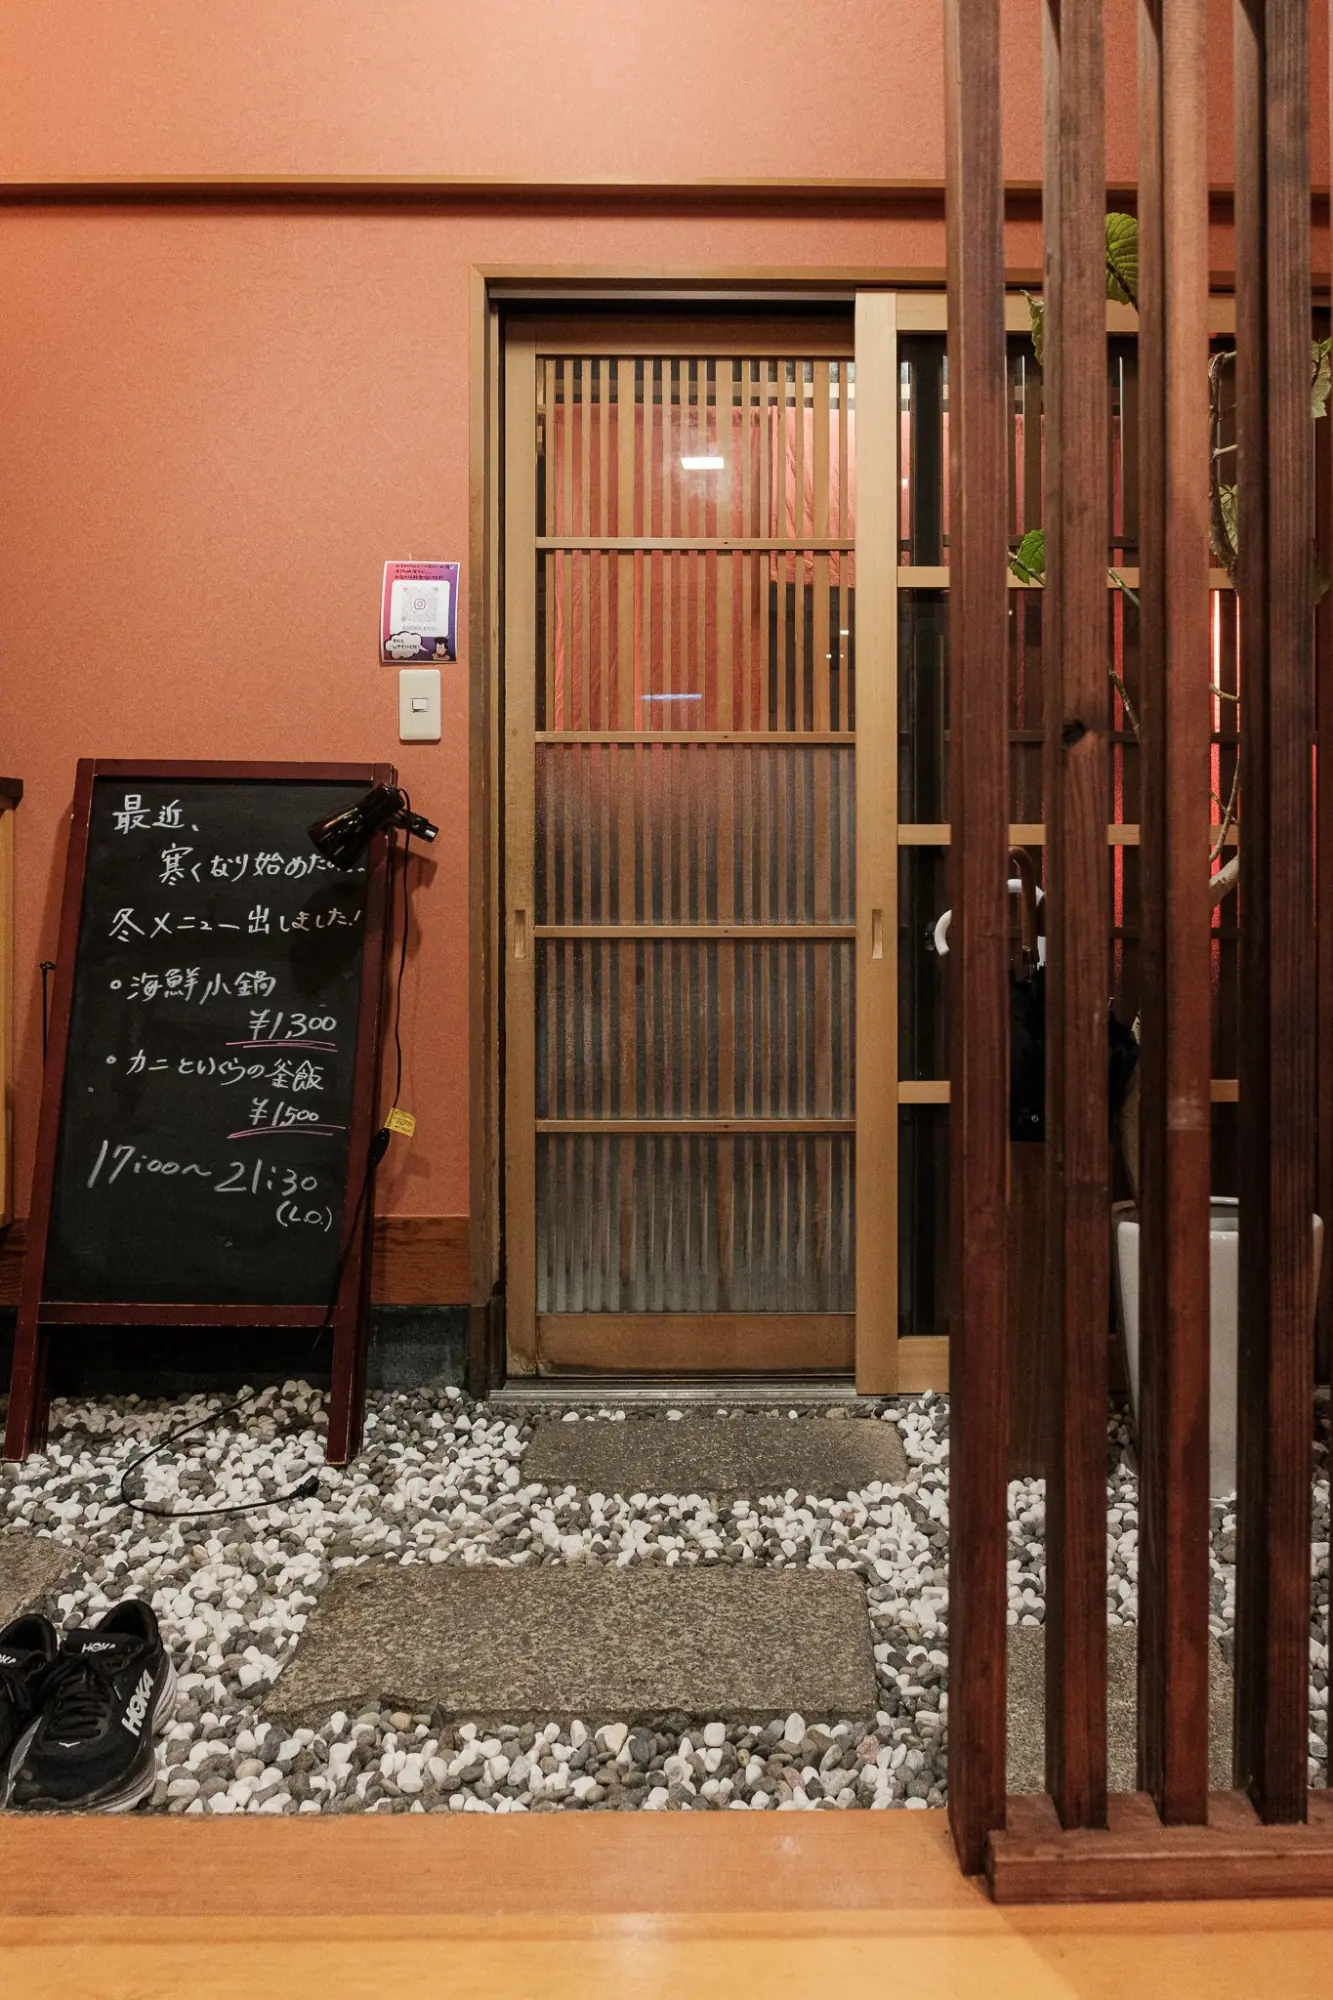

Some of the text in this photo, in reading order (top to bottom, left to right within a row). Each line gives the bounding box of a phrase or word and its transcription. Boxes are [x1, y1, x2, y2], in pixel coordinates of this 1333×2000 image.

[112, 794, 199, 834] 最近、
[126, 967, 277, 1005] 海鮮小鍋
[248, 1008, 338, 1041] ¥1,300
[126, 1049, 325, 1092] カニといくらの釜飯
[121, 1668, 155, 1737] HOKA
